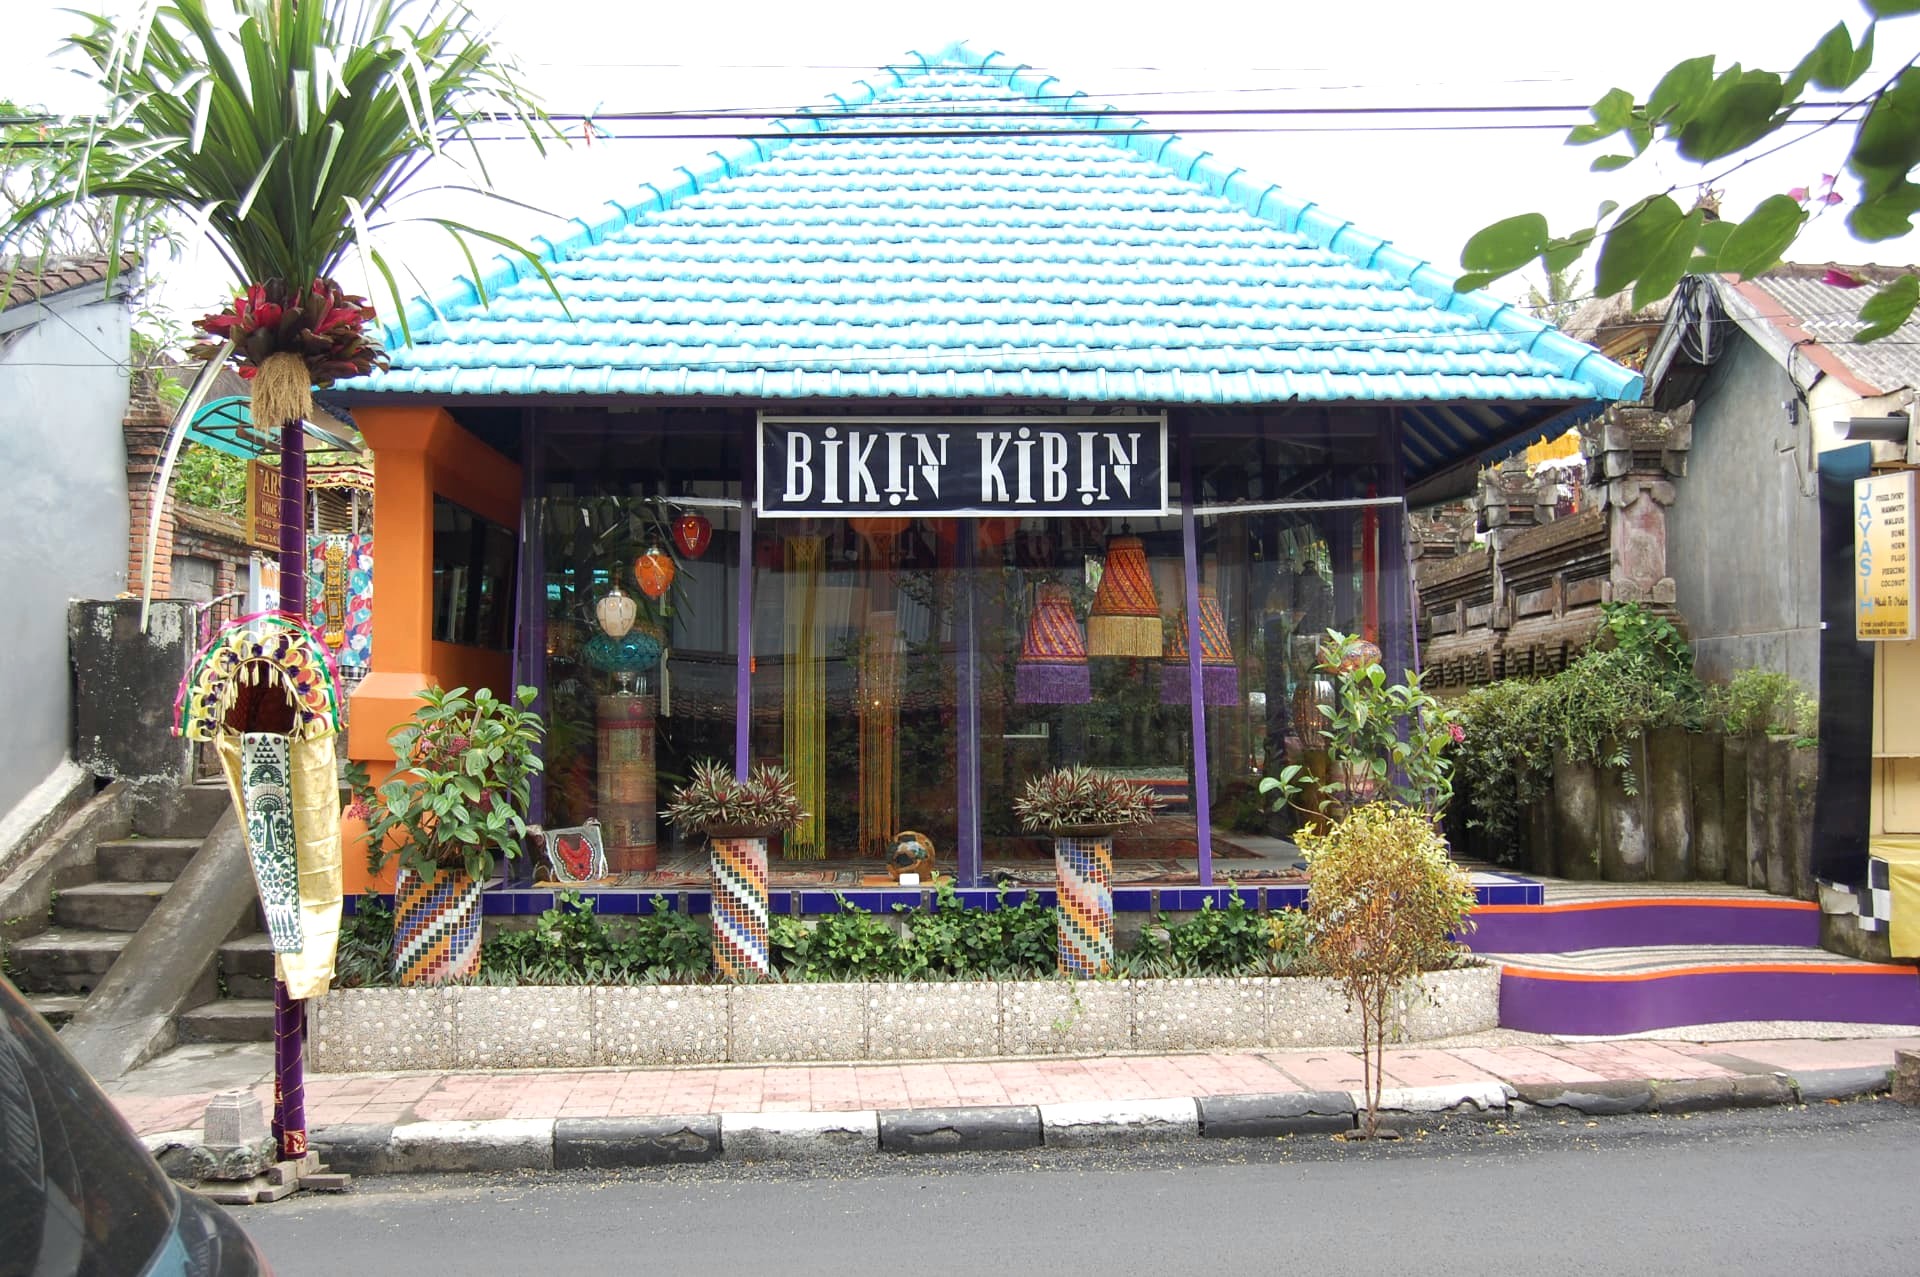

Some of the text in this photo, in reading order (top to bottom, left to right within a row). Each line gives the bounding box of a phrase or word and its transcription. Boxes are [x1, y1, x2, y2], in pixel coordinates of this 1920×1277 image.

[261, 499, 277, 518] HOME
[1881, 504, 1904, 513] MAMMOTH
[1858, 483, 1872, 615] JAYASIH
[1880, 579, 1905, 588] COCONUT
